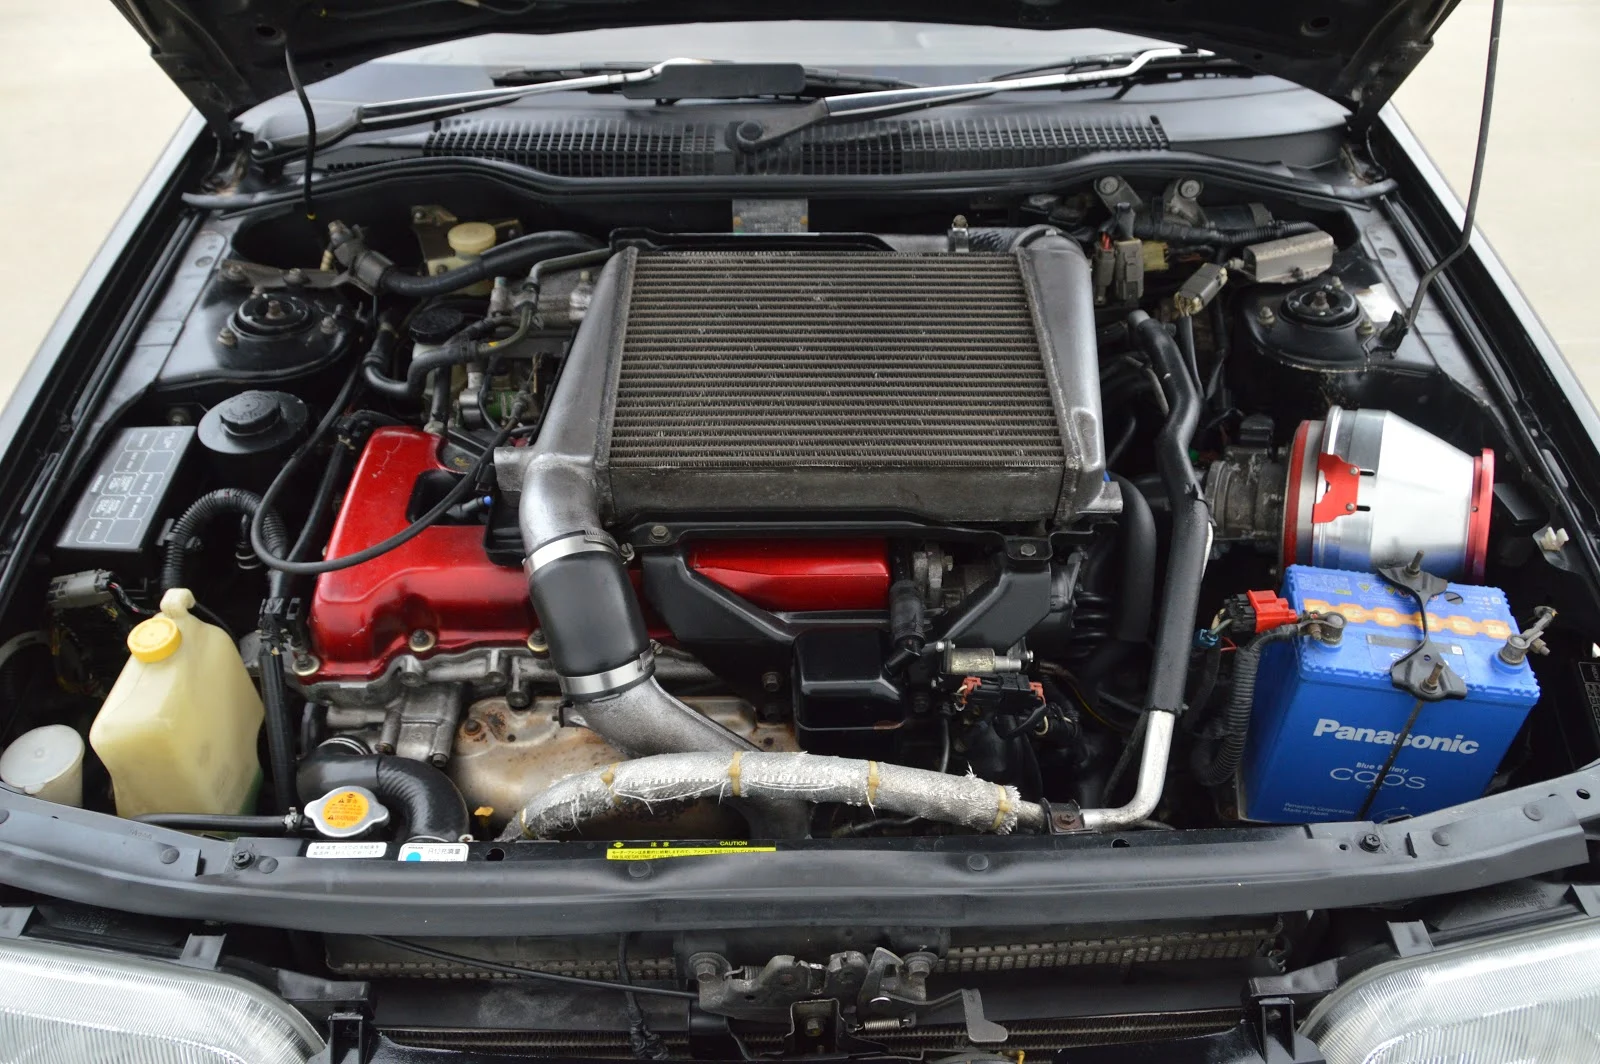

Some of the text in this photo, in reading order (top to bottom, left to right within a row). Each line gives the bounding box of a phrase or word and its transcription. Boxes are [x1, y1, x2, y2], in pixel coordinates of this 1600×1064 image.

[1313, 718, 1480, 755] Panasonic
[1356, 761, 1409, 775] Blue Bttery
